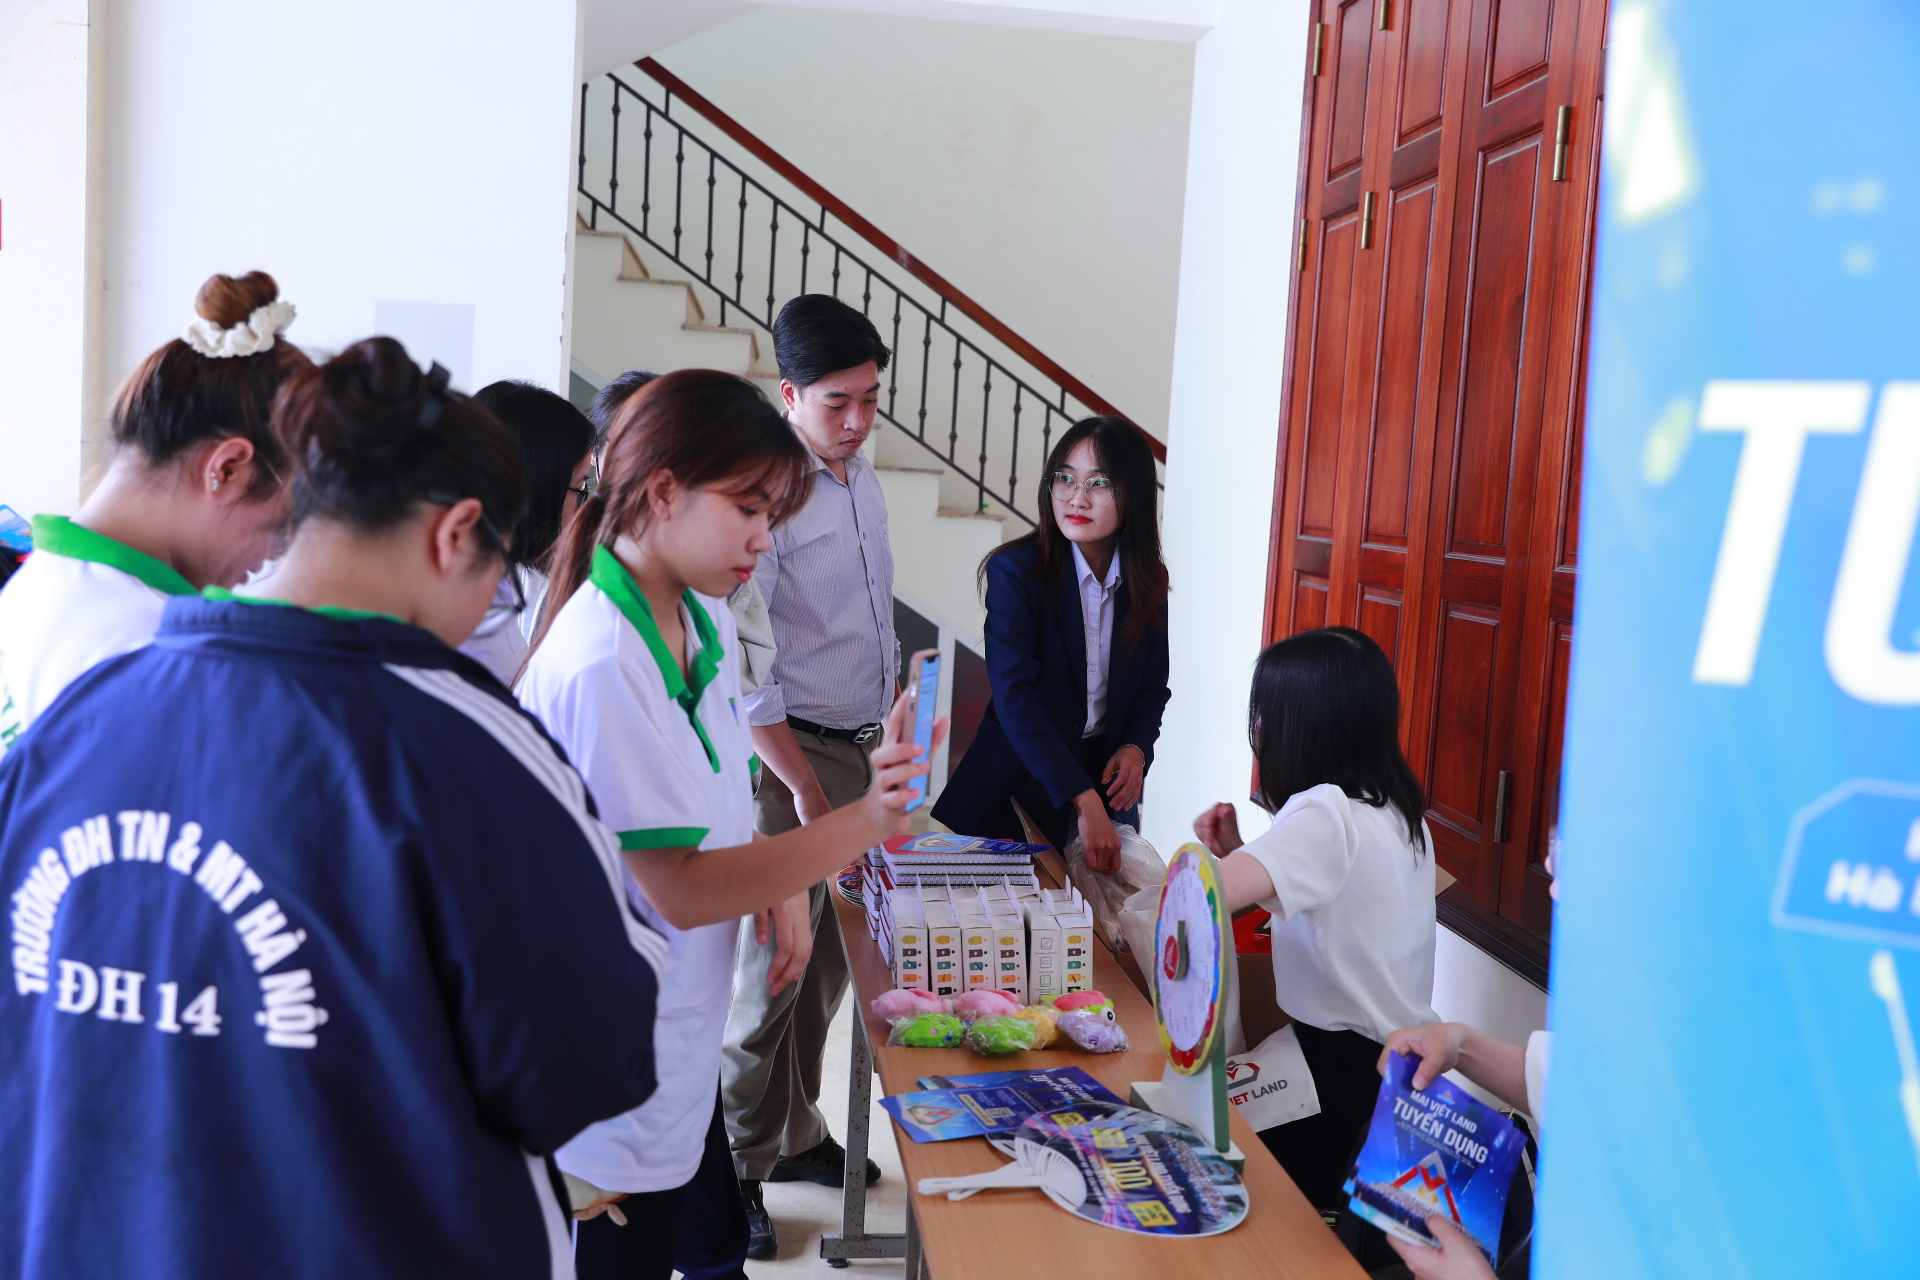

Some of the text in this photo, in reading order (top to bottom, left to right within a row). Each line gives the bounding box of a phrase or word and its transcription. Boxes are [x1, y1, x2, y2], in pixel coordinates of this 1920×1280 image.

[60, 814, 114, 878] ĐH
[117, 810, 171, 863] TN
[167, 821, 203, 876] &
[194, 840, 264, 914] MT
[234, 898, 307, 973] HÀ
[55, 958, 222, 1036] ĐH 14
[254, 968, 329, 1049] NỘI
[1251, 1080, 1288, 1099] LAND
[1410, 1089, 1429, 1107] MAI
[1429, 1099, 1453, 1119] VIỆT
[1451, 1112, 1478, 1134] LAND
[1393, 1096, 1445, 1139] TUYỂN
[1443, 1128, 1489, 1164] DỤNG
[1107, 1158, 1152, 1190] 100
